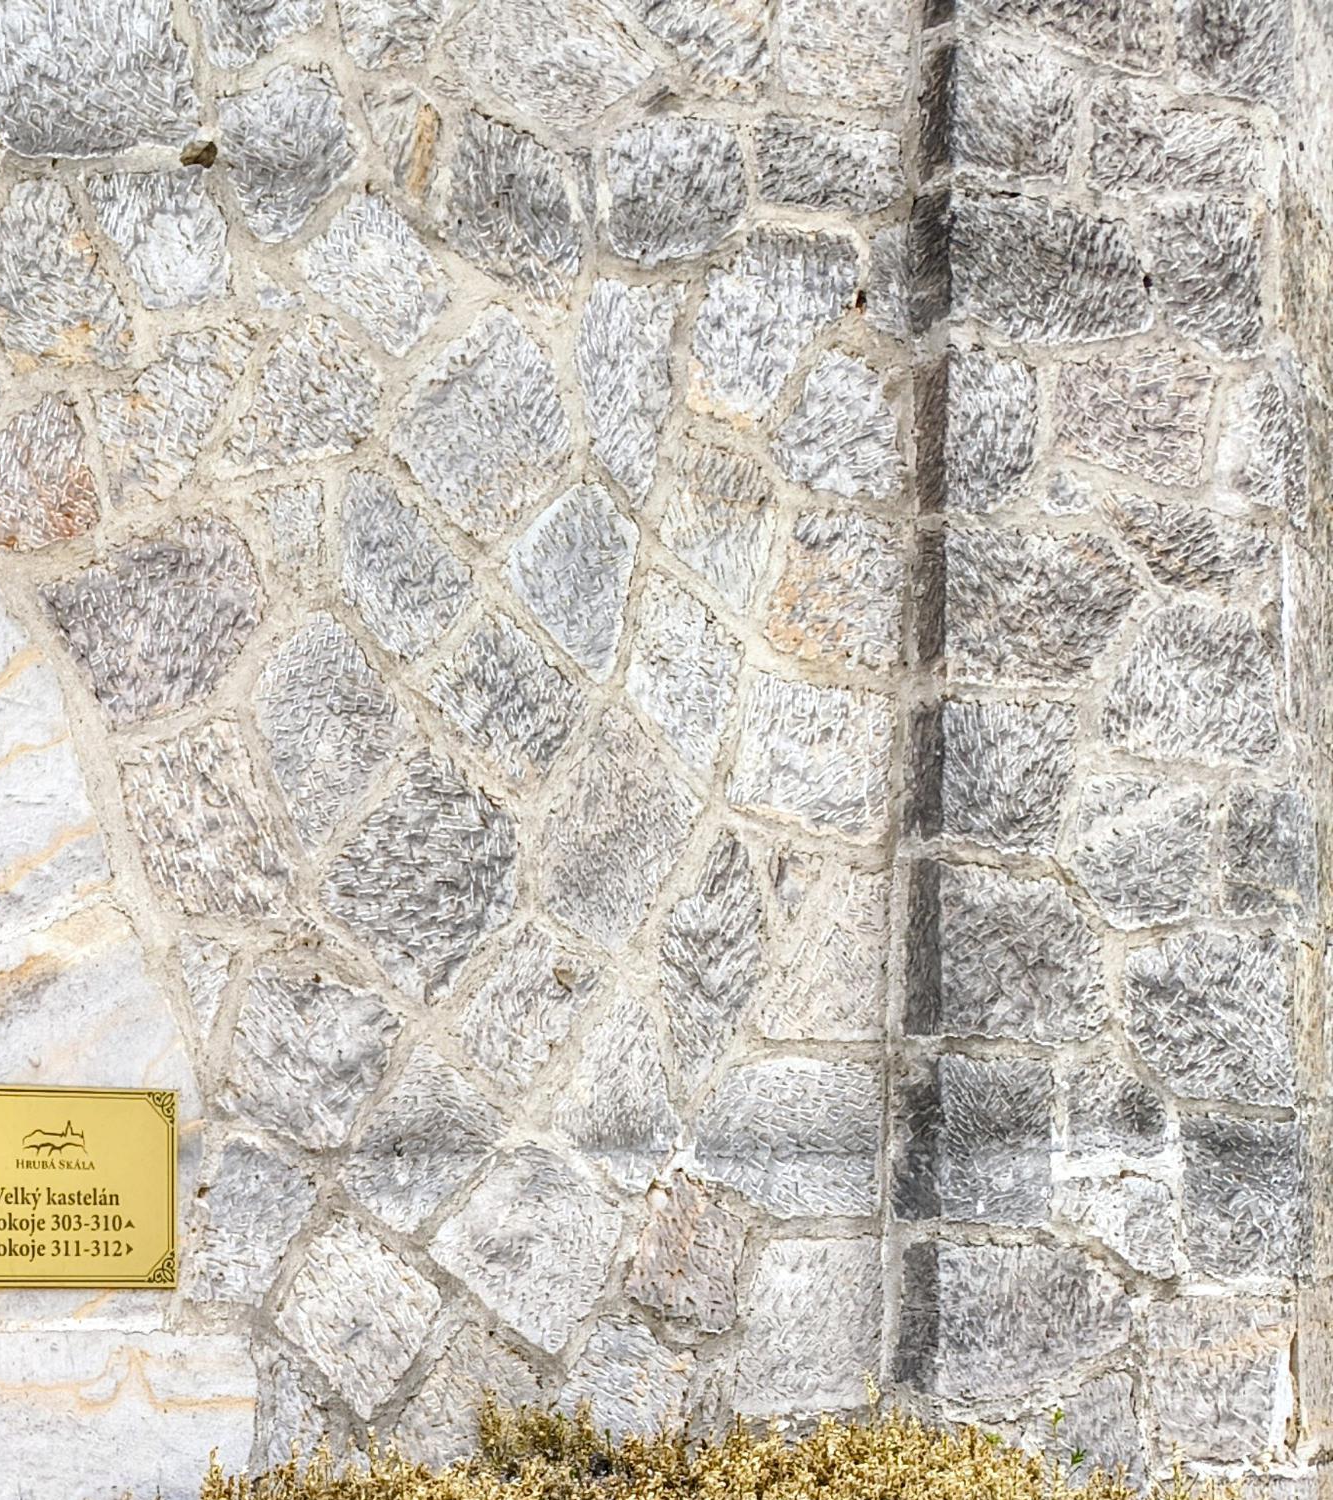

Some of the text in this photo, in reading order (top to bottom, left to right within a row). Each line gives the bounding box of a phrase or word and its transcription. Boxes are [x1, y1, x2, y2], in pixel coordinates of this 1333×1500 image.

[16, 1158, 95, 1170] HRUBÁ SKÁLA
[46, 1187, 120, 1206] kastelán
[50, 1214, 123, 1231] 303-310
[50, 1240, 123, 1258] 311-312
